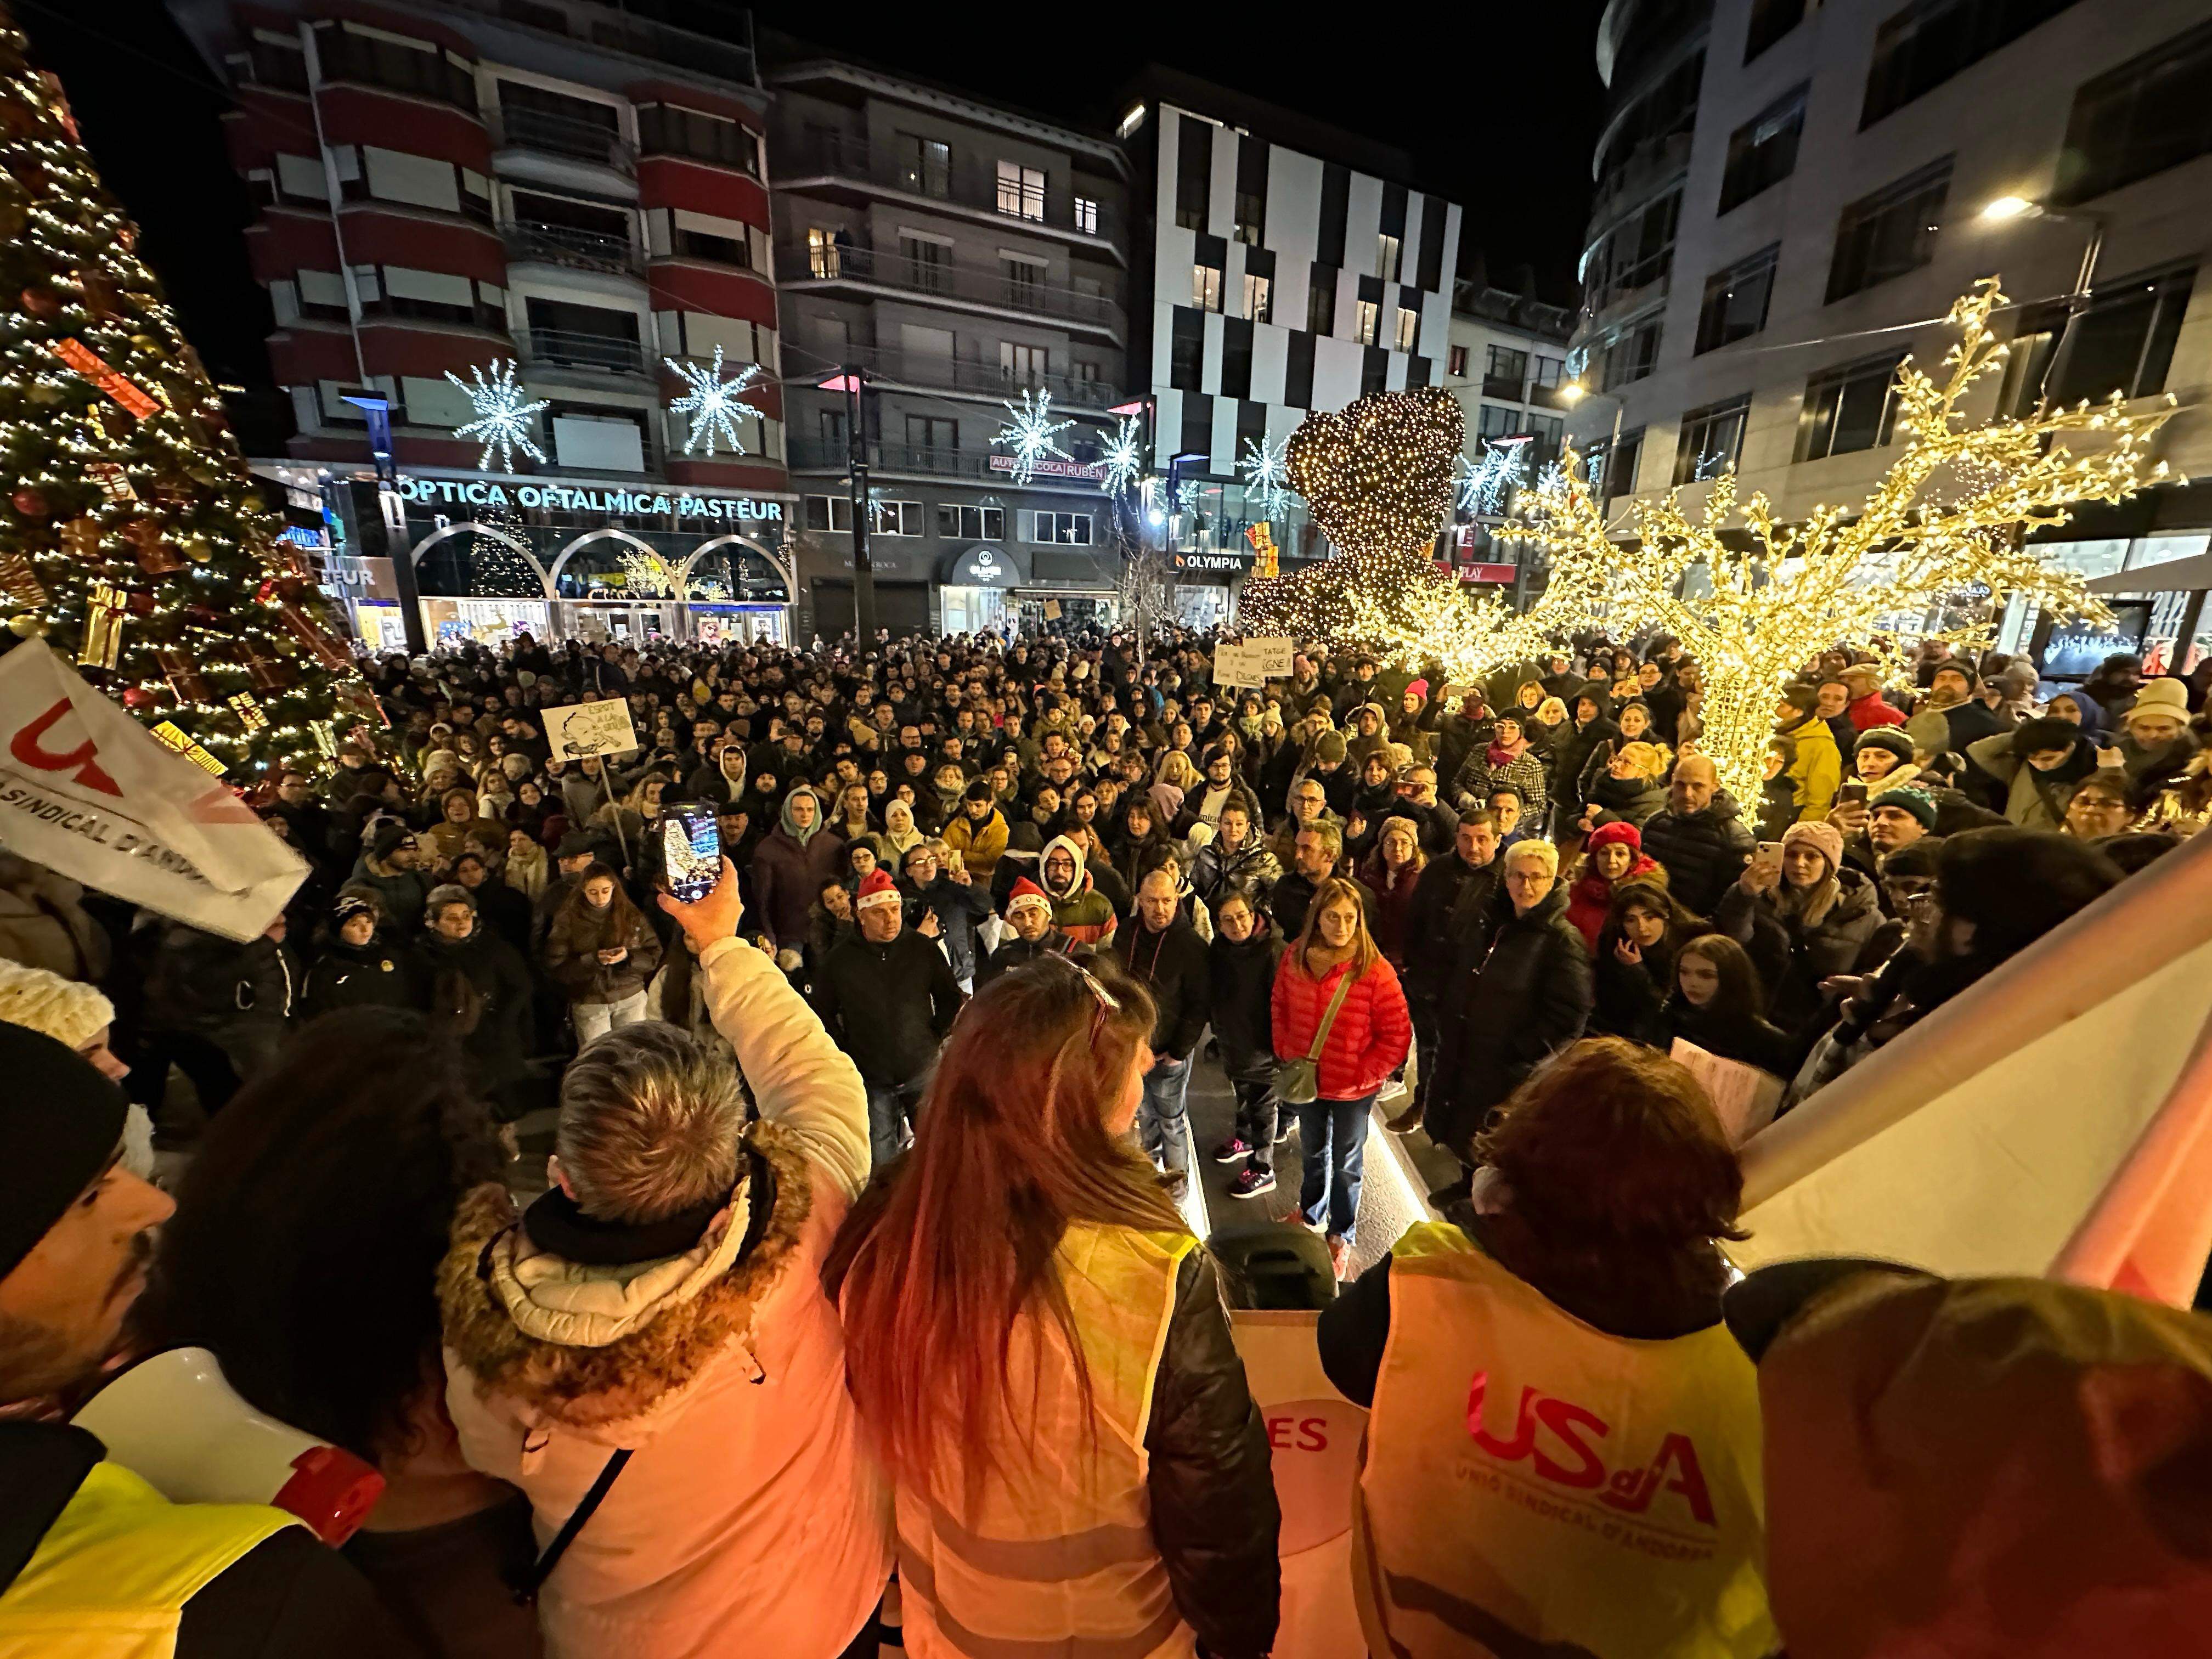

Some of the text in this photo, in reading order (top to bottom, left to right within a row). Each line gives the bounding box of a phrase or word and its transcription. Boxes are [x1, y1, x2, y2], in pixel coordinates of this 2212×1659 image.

[679, 495, 782, 521] PASTEUR
[1187, 555, 1243, 569] OLYMPIA
[0, 789, 109, 844] SINDICAL
[1468, 1372, 1717, 1528] USdA
